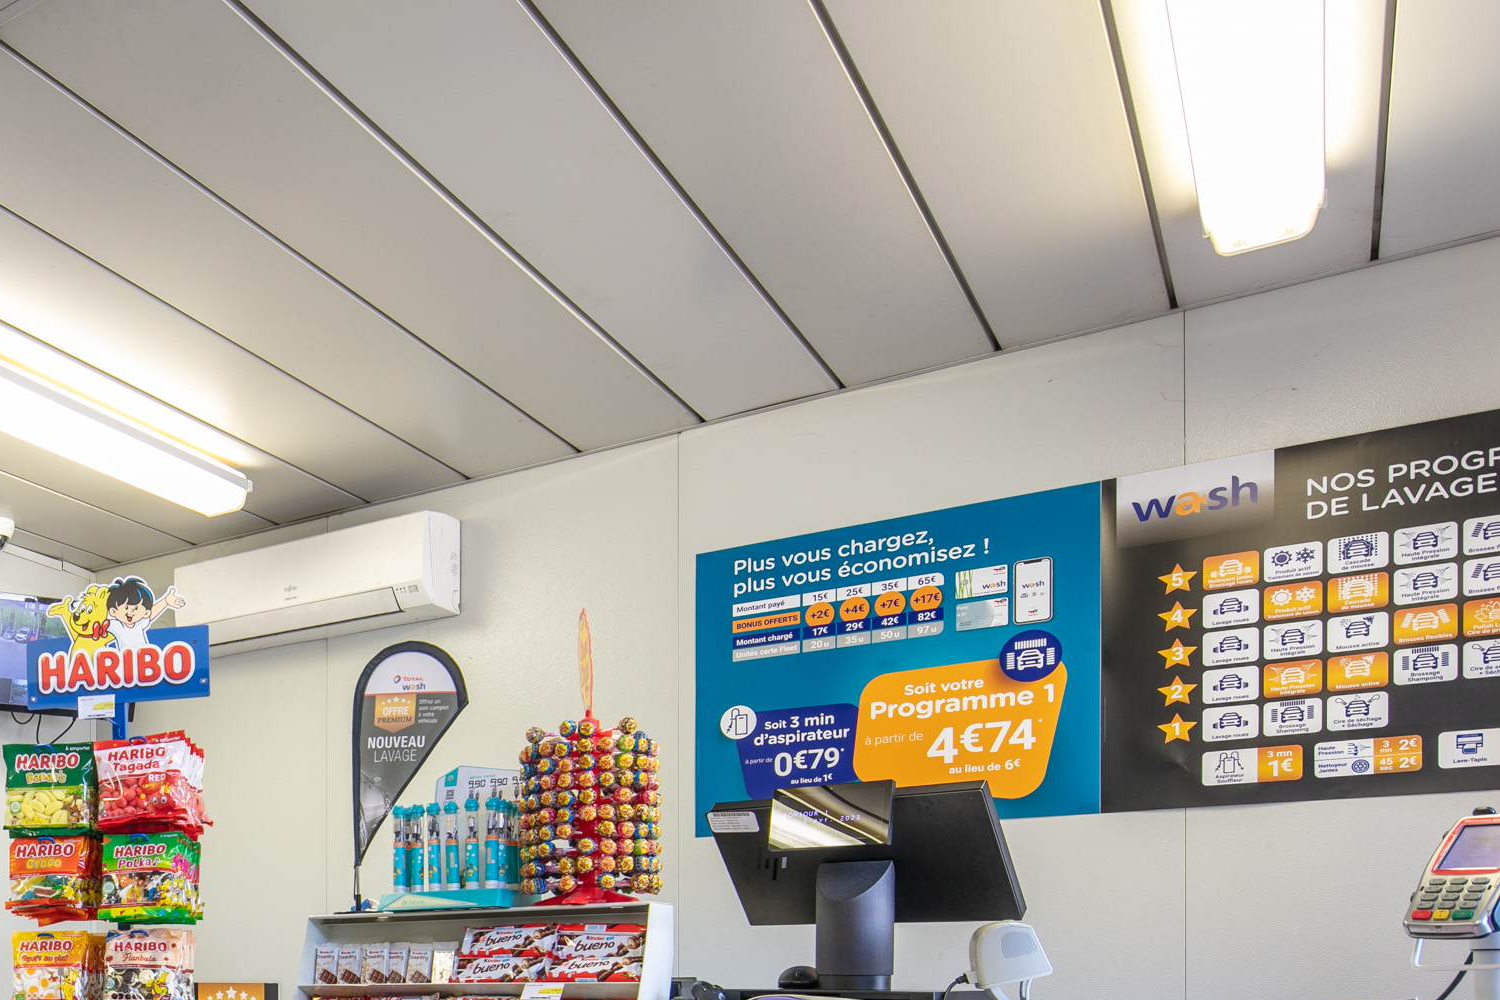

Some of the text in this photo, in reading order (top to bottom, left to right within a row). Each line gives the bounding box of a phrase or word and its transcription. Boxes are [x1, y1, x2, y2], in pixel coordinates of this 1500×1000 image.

[1307, 468, 1376, 497] NOS
[1132, 475, 1258, 522] wash
[1307, 472, 1498, 520] DE LAVAGE
[734, 530, 934, 576] Plus vous chargez,
[734, 577, 775, 598] plus
[782, 567, 831, 587] vous
[838, 543, 975, 577] économisez
[881, 581, 899, 592] 35€
[917, 576, 936, 586] 65€
[1171, 572, 1184, 587] 5
[812, 593, 829, 602] 15€
[846, 587, 864, 597] 25€
[913, 592, 940, 605] +17€
[736, 599, 785, 614] Montant payé
[844, 603, 865, 615] +4€
[880, 598, 900, 609] +7€
[810, 608, 830, 620] +2€
[881, 616, 900, 626] 42€
[917, 610, 936, 621] 82€
[1170, 609, 1184, 623] 4
[736, 614, 798, 631] BONUS OFFERTS
[846, 621, 864, 631] 29€
[812, 626, 829, 637] 17€
[736, 632, 793, 648] Montant chargé
[1171, 646, 1184, 661] 3
[41, 645, 192, 691] HARIBO
[402, 683, 426, 691] wash
[904, 678, 985, 697] Soit votre
[1170, 684, 1183, 700] 2
[870, 683, 1055, 721] Programme 1
[382, 706, 409, 716] OFFRE
[377, 716, 413, 724] PREMIUM
[764, 712, 835, 730] Soit 3 min
[1171, 722, 1180, 736] 1
[368, 735, 426, 750] NOUVEAU
[864, 730, 924, 748] à partir de
[1382, 740, 1390, 748] 3
[1399, 738, 1418, 750] 2€
[108, 747, 165, 762] HARIBO
[373, 749, 417, 763] LAVAGE
[1267, 750, 1274, 758] 3
[1318, 749, 1344, 757] Pression
[16, 754, 80, 770] HARIBO
[112, 759, 160, 774] Tagada
[948, 758, 1021, 775] au lieu de 6€
[1268, 758, 1293, 777] 1€
[148, 774, 166, 782] RED
[840, 814, 861, 822] 2023
[19, 940, 74, 952] HARIBO
[486, 933, 522, 947] bueno
[574, 940, 615, 952] bueno
